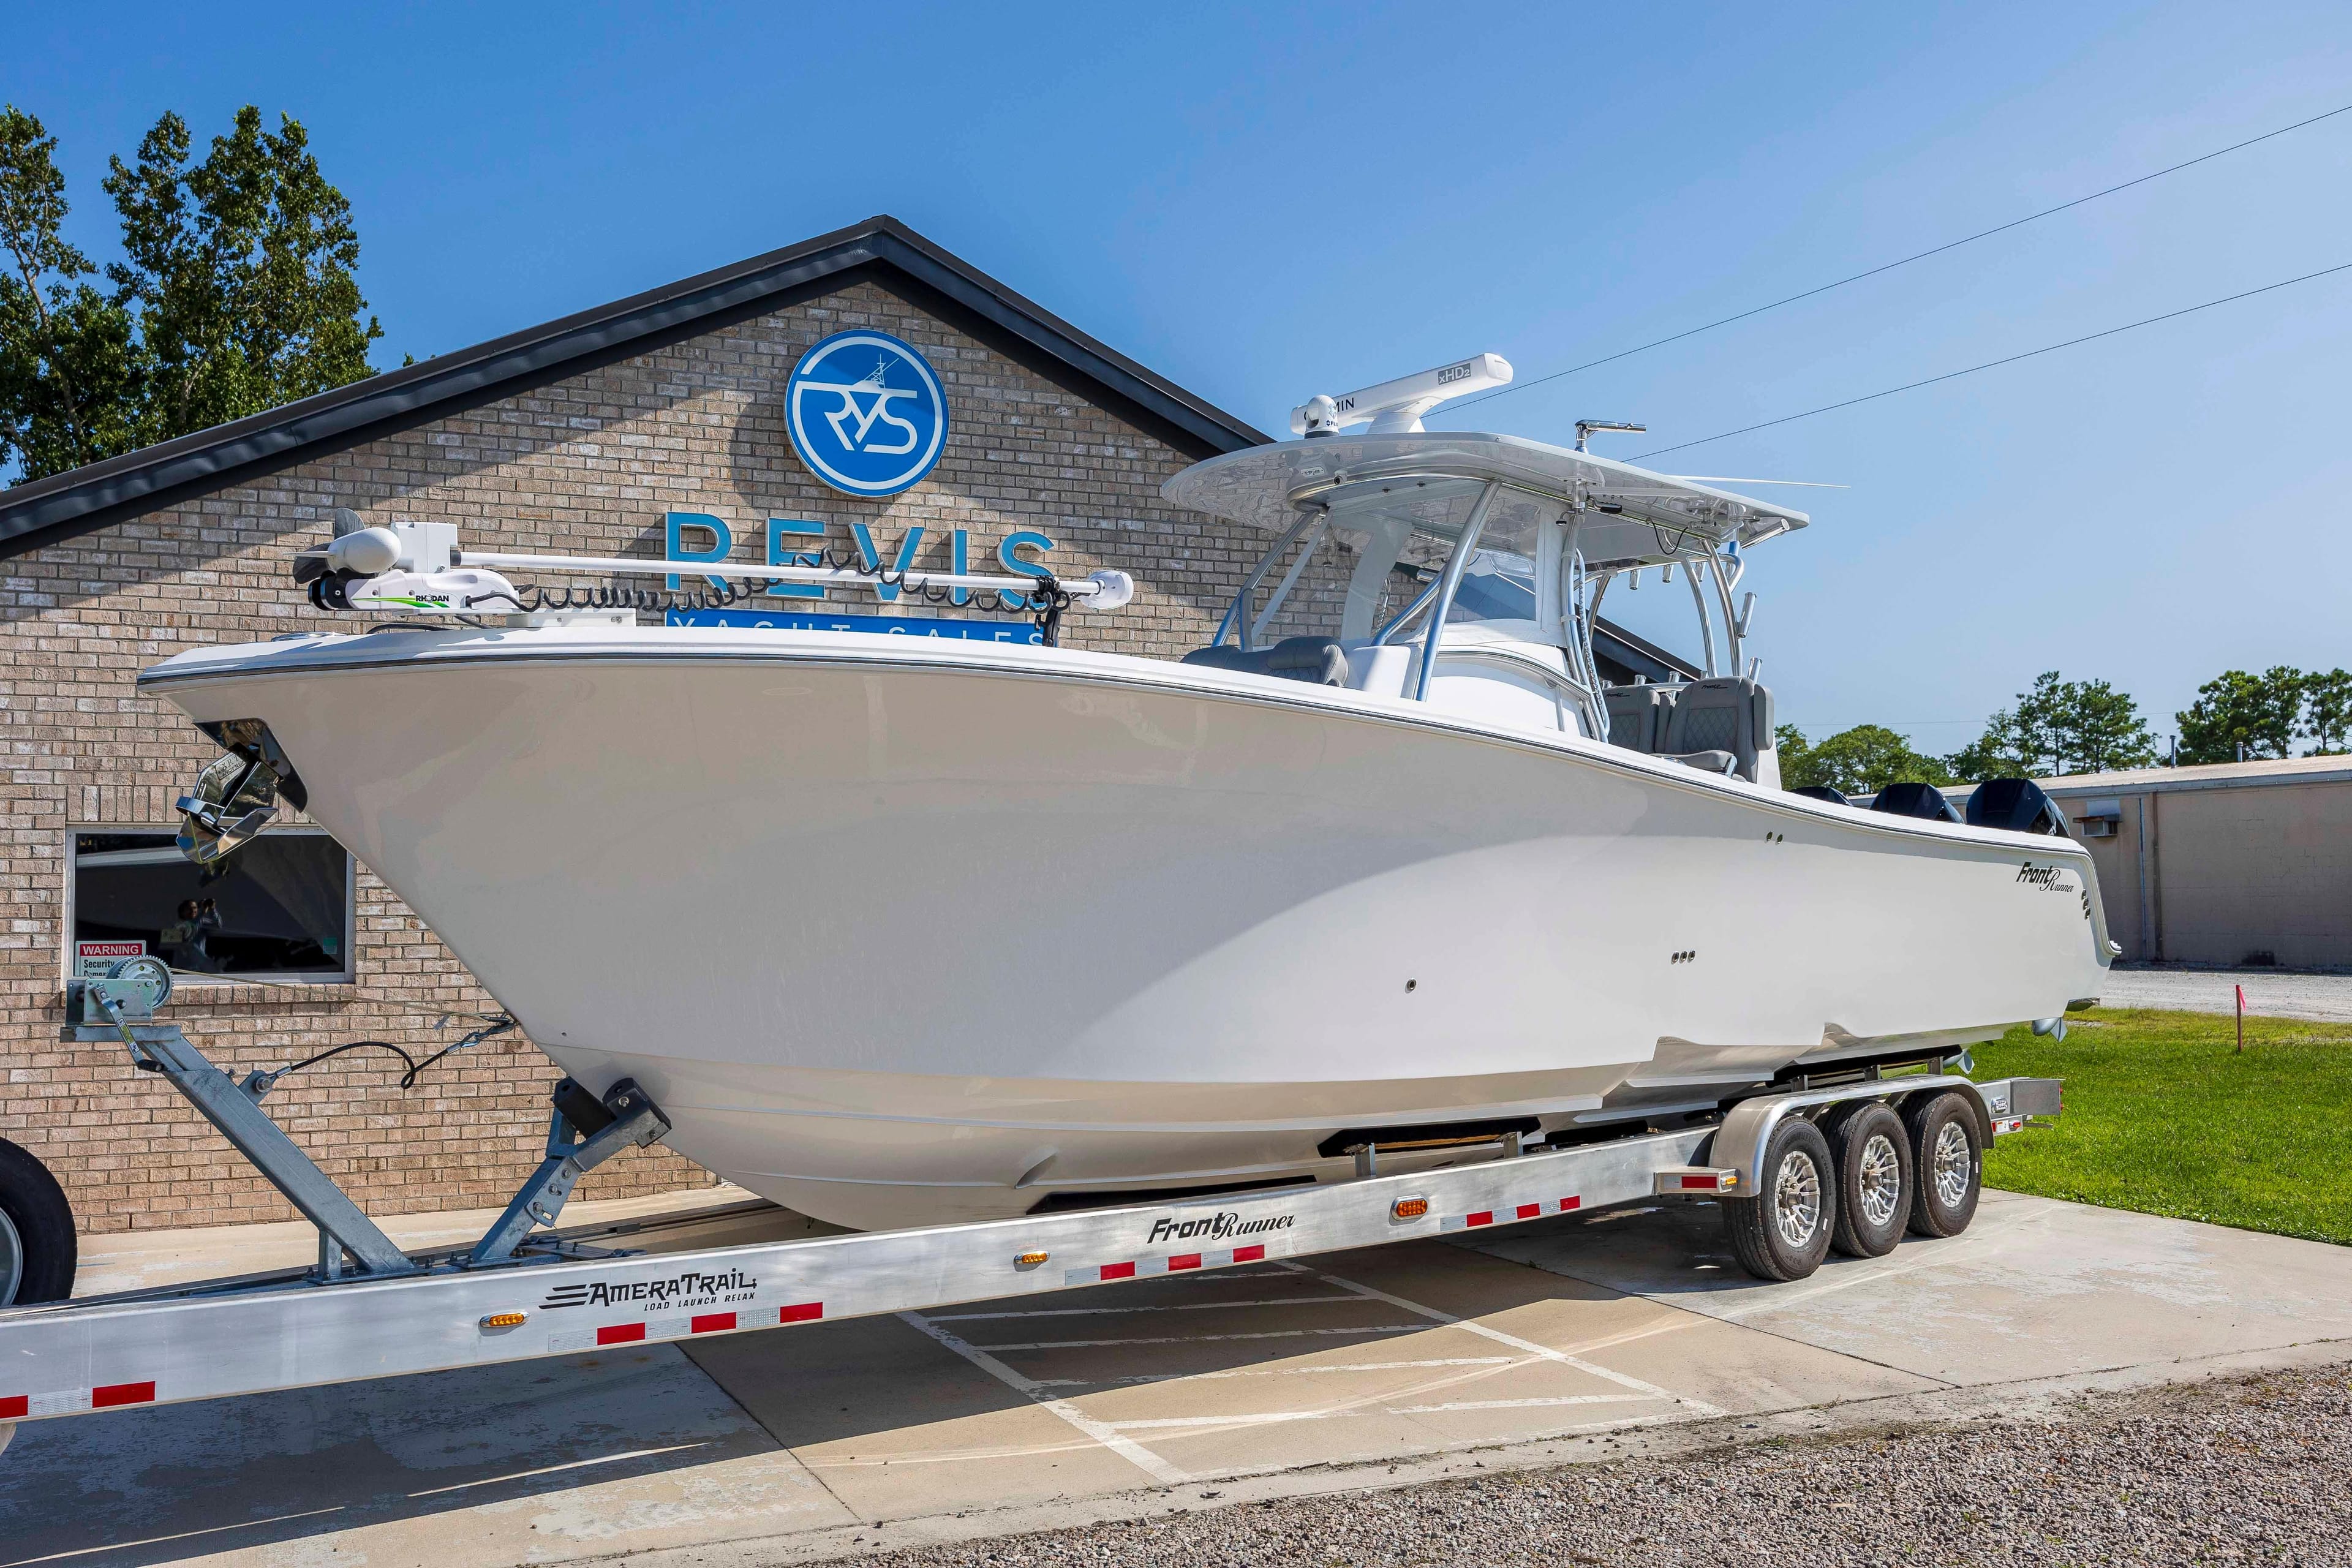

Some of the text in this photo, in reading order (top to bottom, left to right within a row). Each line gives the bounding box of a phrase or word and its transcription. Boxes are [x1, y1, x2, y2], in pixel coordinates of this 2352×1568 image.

[666, 511, 1055, 611] REVIS
[83, 945, 139, 956] WARNING
[84, 959, 115, 968] Security
[644, 1292, 755, 1311] LOAD LAUNCH RELAX
